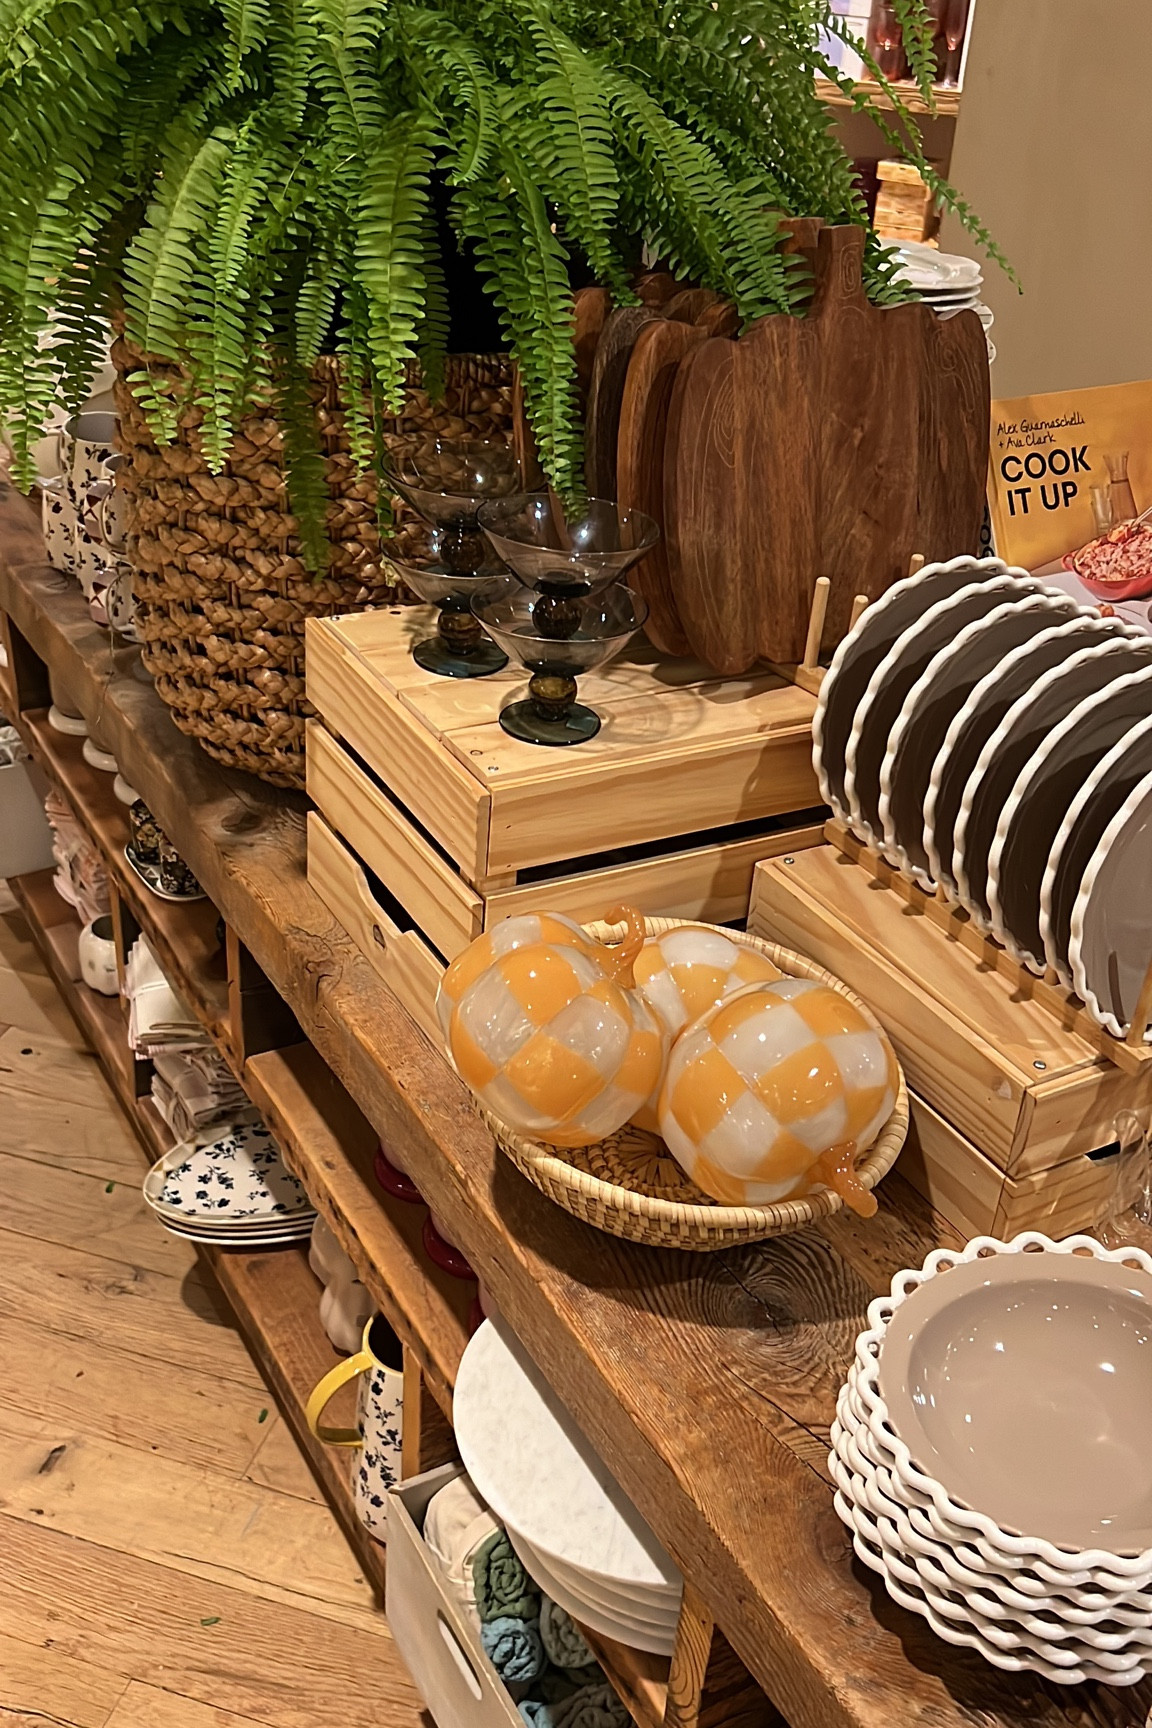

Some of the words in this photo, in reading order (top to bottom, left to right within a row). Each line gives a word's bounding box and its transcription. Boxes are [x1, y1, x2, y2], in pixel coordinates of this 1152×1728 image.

[997, 421, 1018, 436] Alex
[1006, 437, 1024, 449] Ava
[1025, 431, 1056, 446] Clark
[1001, 445, 1091, 482] COOK
[1007, 487, 1031, 516] IT
[1040, 481, 1078, 510] UP
